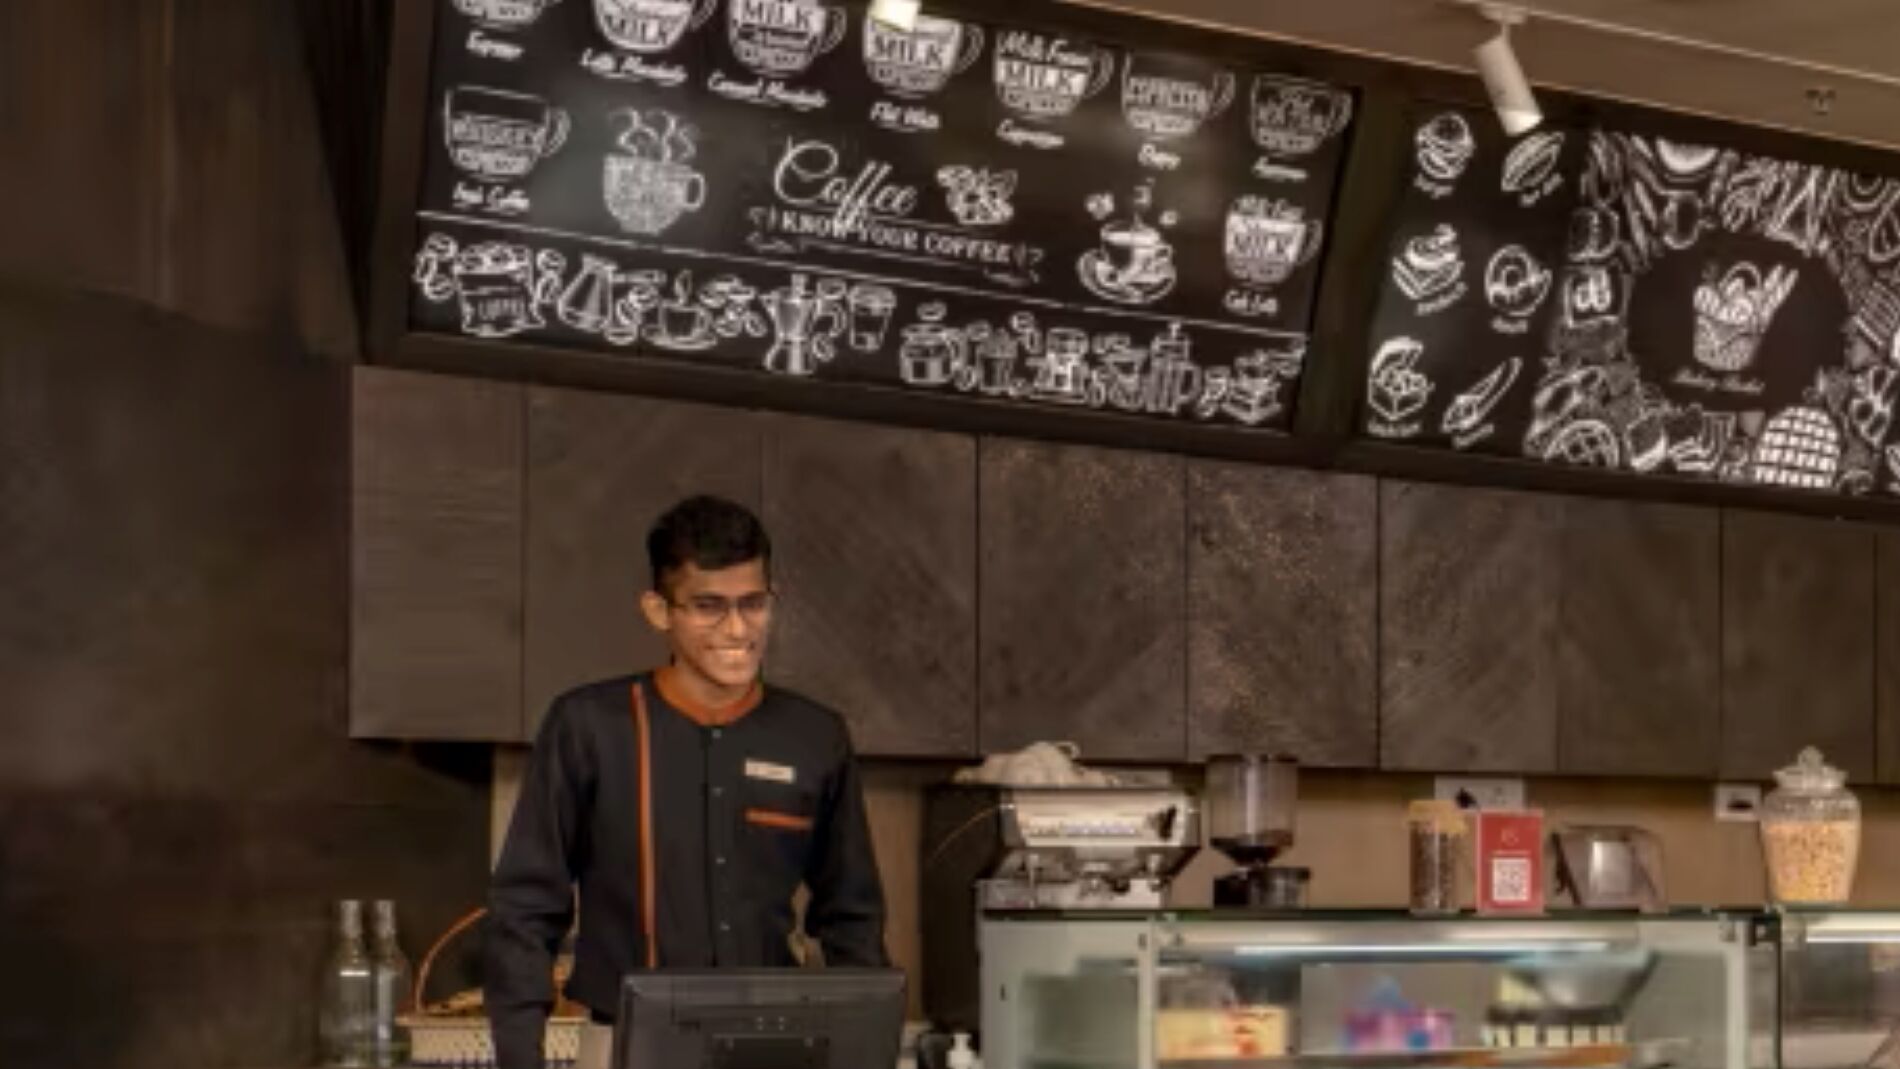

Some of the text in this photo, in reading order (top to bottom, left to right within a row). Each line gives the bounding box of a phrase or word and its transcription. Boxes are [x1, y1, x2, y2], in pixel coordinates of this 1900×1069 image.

[873, 35, 944, 68] MILK
[774, 137, 918, 232] Coffee
[782, 209, 1012, 264] KNOW YOUR COFFEE
